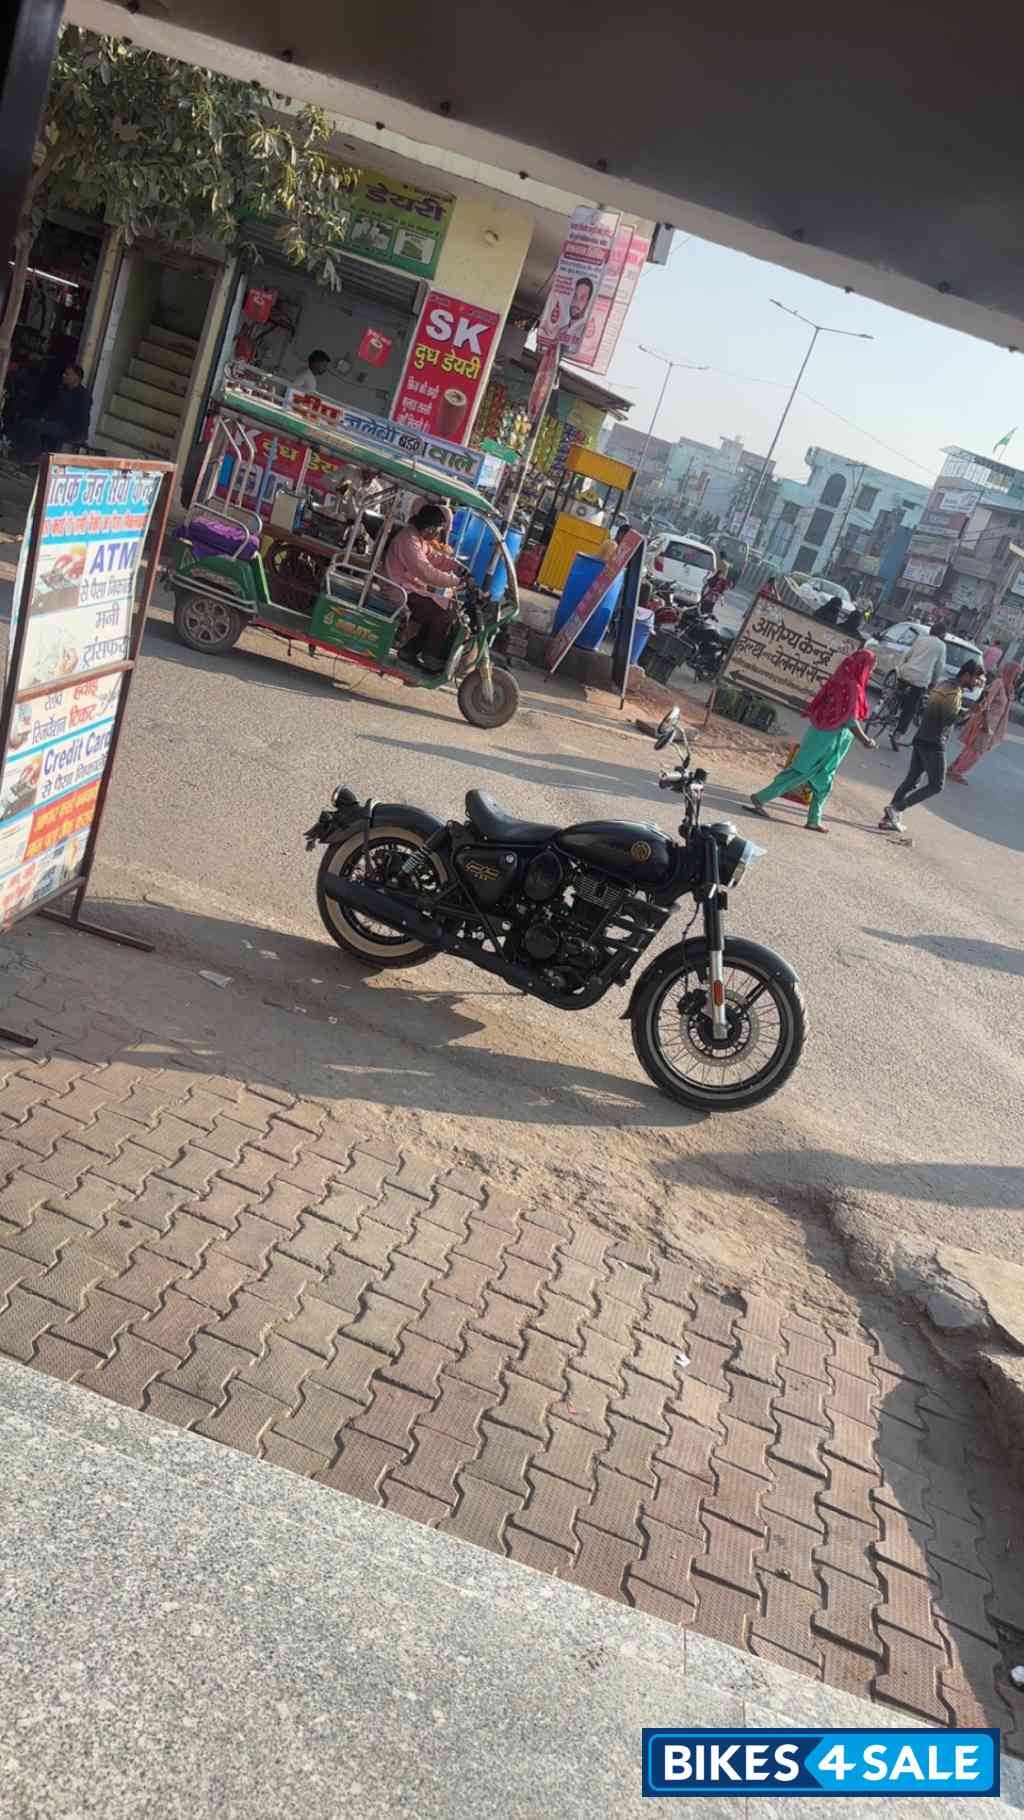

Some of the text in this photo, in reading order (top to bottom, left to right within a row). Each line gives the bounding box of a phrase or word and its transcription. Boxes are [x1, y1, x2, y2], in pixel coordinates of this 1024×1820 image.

[425, 308, 489, 355] SK
[441, 349, 480, 379] डेयरी
[89, 541, 139, 575] ATM
[95, 602, 120, 629] मनी
[44, 736, 83, 776] Credit
